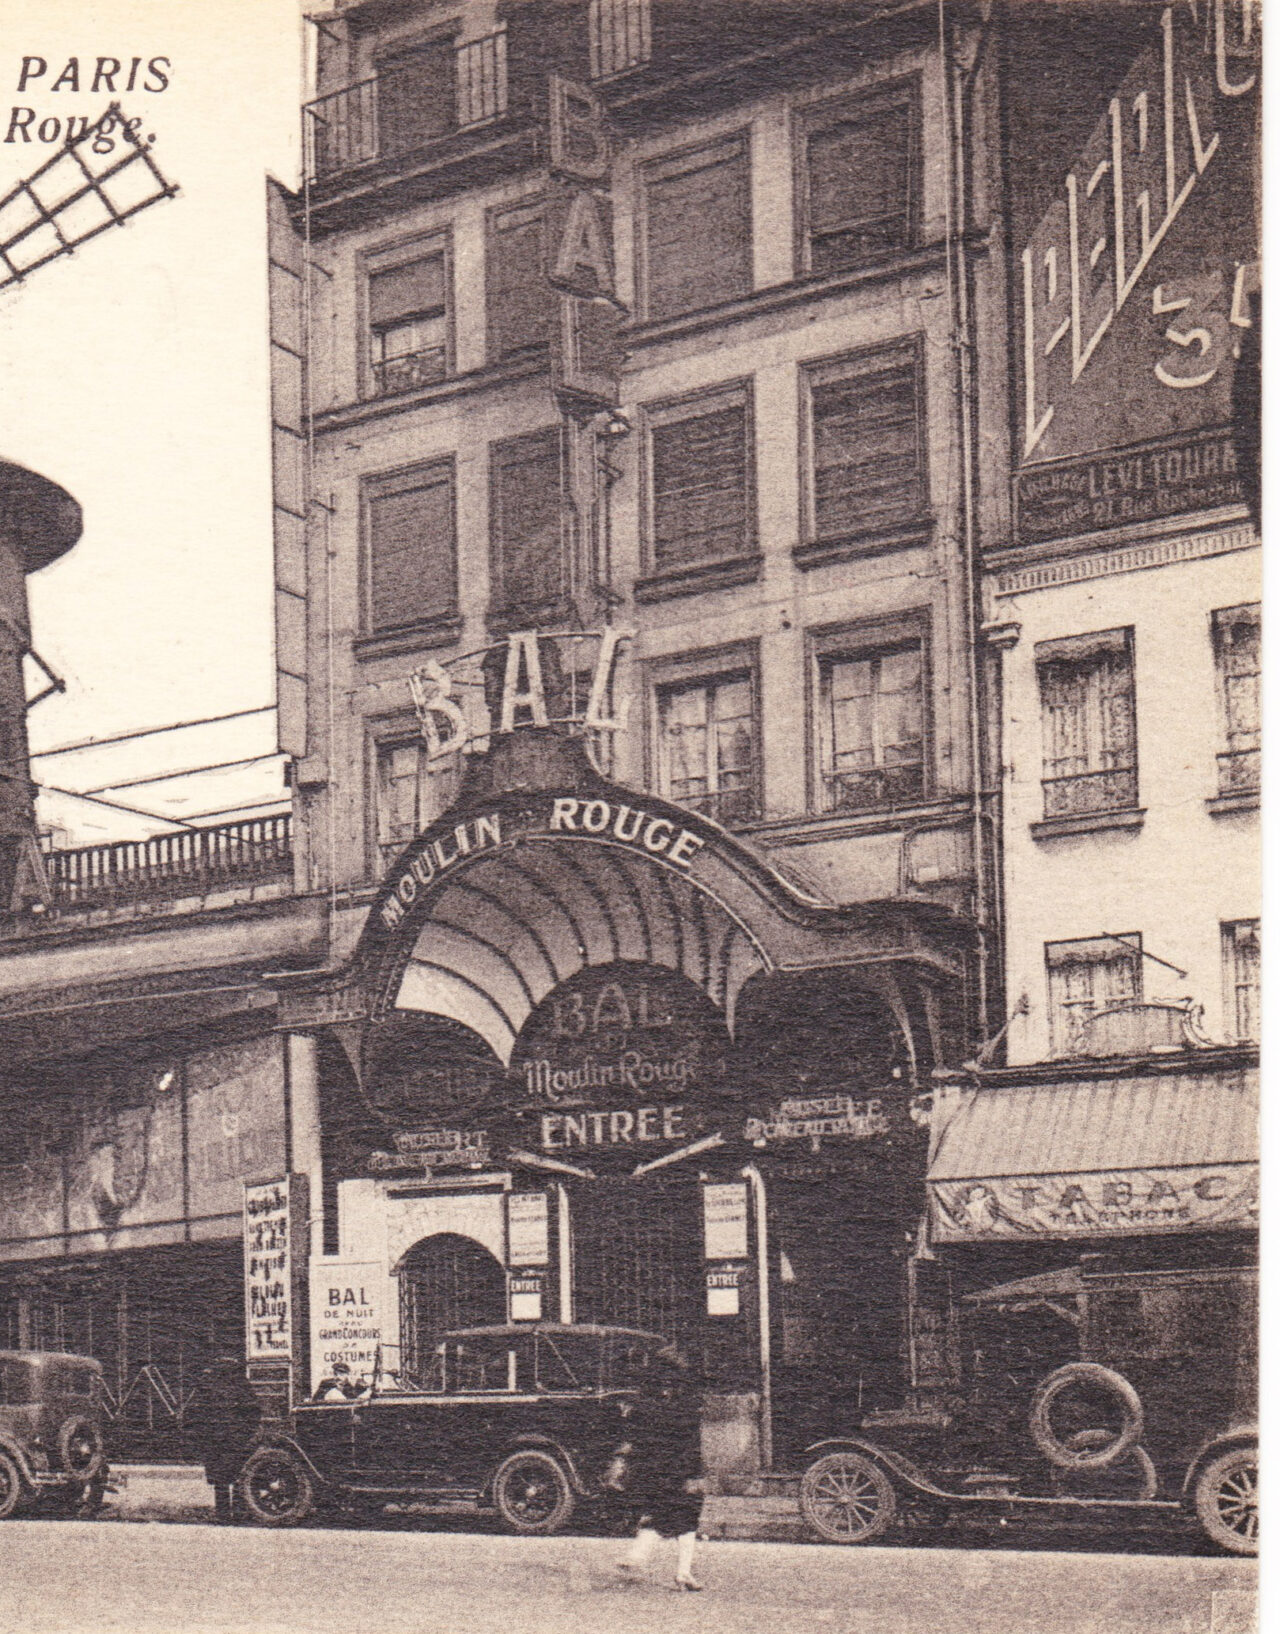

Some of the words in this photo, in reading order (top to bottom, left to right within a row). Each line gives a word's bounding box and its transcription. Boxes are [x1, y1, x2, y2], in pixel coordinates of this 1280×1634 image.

[409, 624, 637, 761] BAL
[378, 813, 502, 931] MOULIN
[549, 797, 705, 868] ROUGE
[553, 983, 672, 1036] BAL
[522, 1056, 616, 1101] Moulin
[541, 1105, 687, 1149] ENTREE
[1014, 1176, 1227, 1210] TABAC
[324, 1310, 339, 1319] DE
[346, 1309, 374, 1319] NUIT
[328, 1287, 370, 1307] BAL
[323, 1351, 379, 1363] COSTUMES
